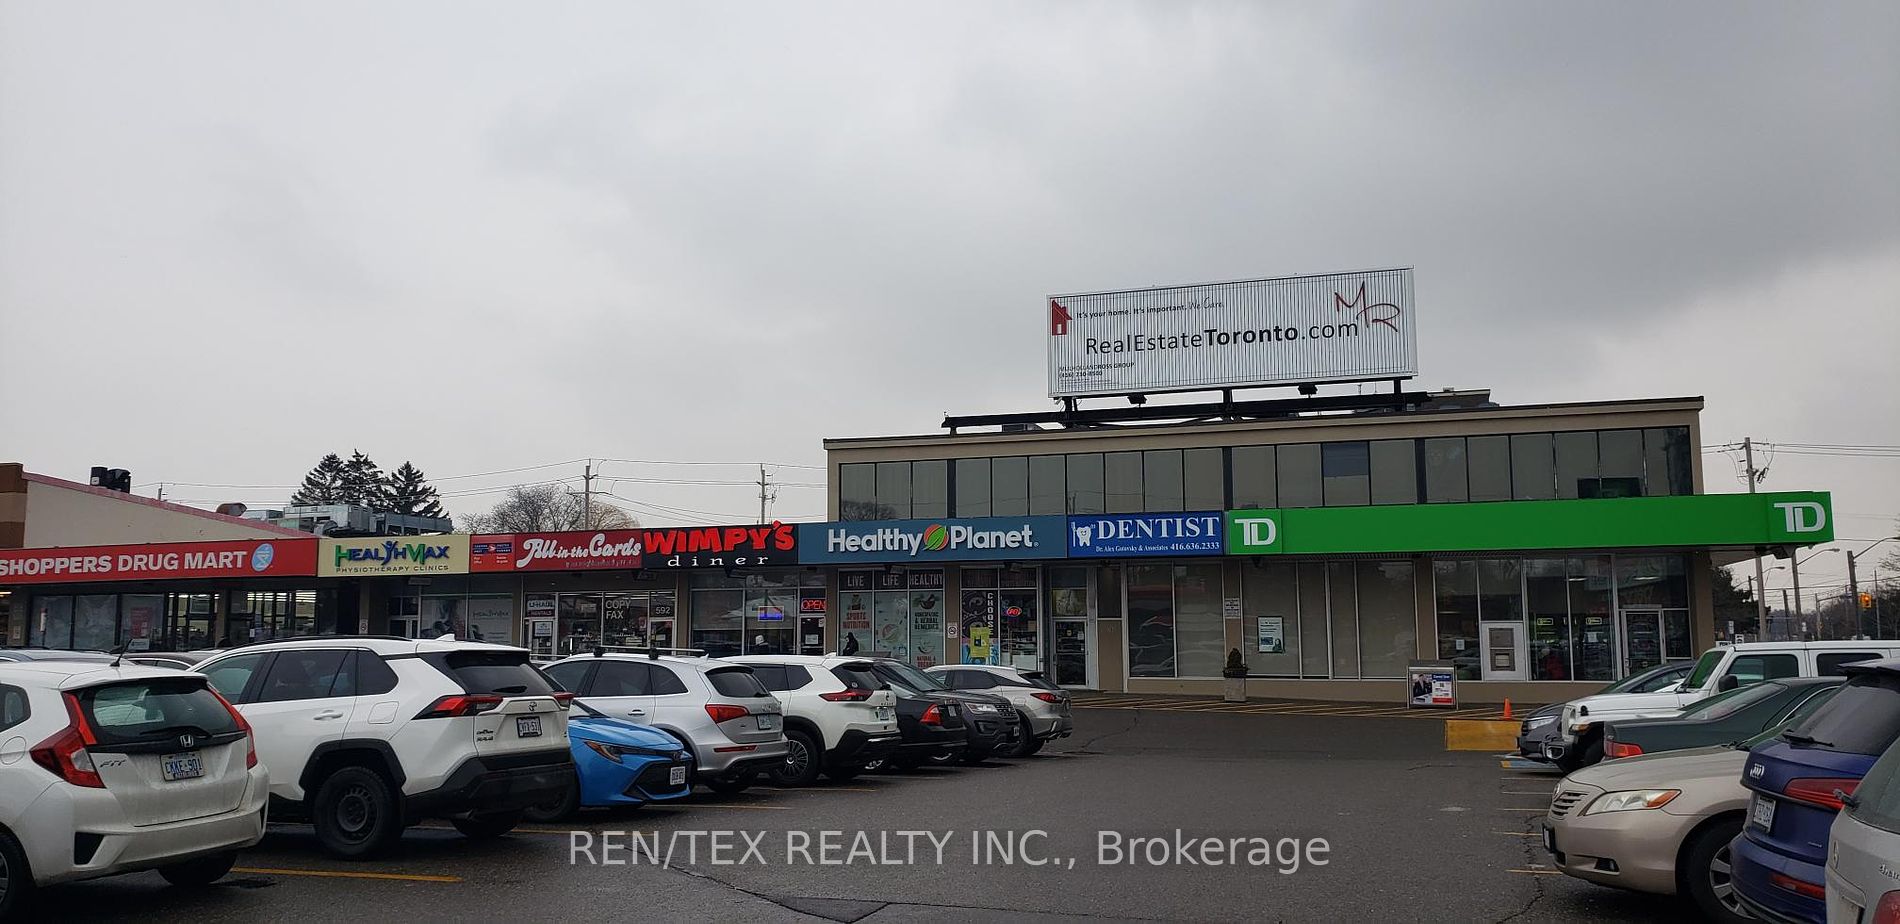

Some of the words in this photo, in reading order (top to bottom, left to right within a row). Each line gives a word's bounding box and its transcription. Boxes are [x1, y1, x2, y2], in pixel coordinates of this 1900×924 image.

[1076, 311, 1088, 319] It's
[1089, 311, 1106, 321] your
[1107, 308, 1131, 317] home.
[1133, 307, 1145, 315] It's
[1086, 322, 1358, 355] RealEstateToronto.com
[1113, 361, 1135, 369] GROUP
[1773, 501, 1826, 533] TD
[1097, 515, 1220, 540] DENTIST
[1234, 518, 1277, 546] TD
[644, 520, 796, 556] WIMPY'S
[828, 527, 924, 556] Healthy
[1144, 544, 1168, 552] Associates
[1170, 541, 1220, 551] 416.636.2333
[0, 555, 112, 576] SHOPPERS
[117, 553, 179, 573] DRUG
[184, 550, 248, 570] MART
[667, 554, 770, 568] diner
[336, 565, 410, 574] PHYSIOTHERAPY
[413, 564, 449, 572] CLINICS
[847, 575, 865, 587] LIVE
[882, 574, 900, 586] LIFE
[909, 573, 943, 586] HEALTHY
[605, 599, 631, 609] COPY
[655, 606, 671, 615] 592
[802, 599, 827, 610] OPEN
[606, 610, 624, 620] FAX
